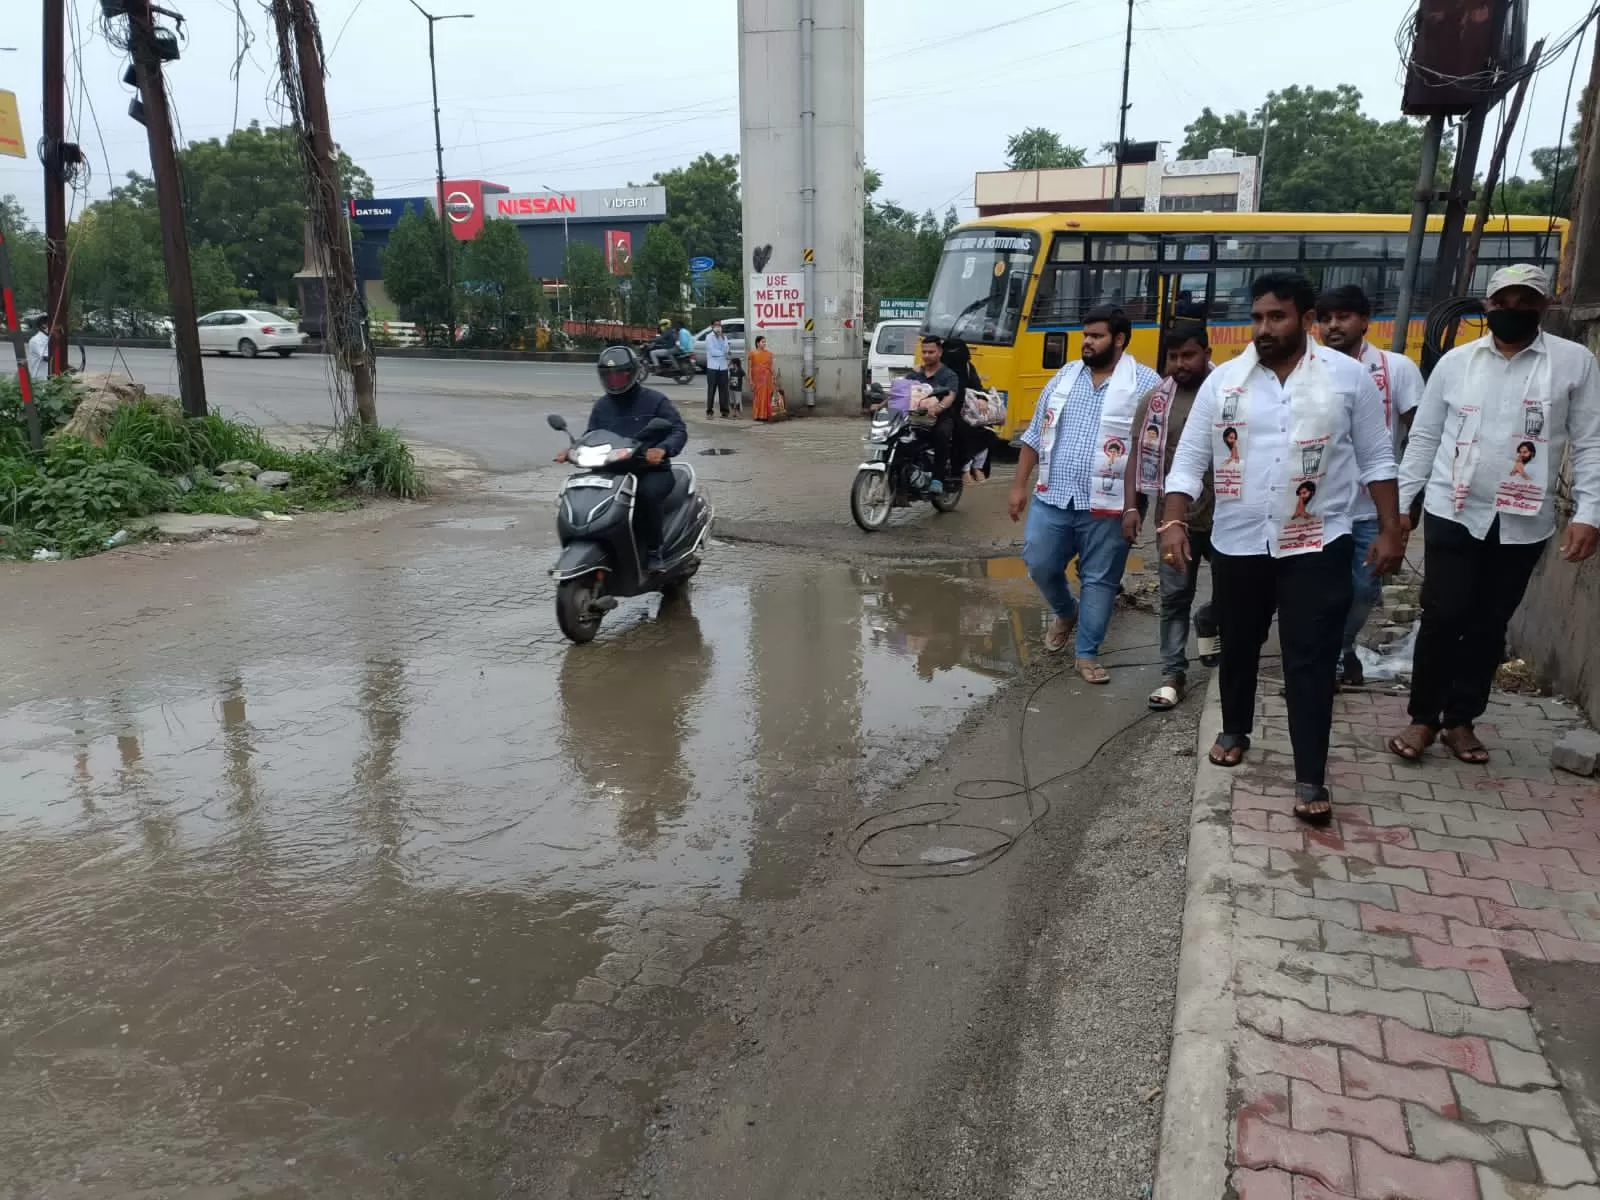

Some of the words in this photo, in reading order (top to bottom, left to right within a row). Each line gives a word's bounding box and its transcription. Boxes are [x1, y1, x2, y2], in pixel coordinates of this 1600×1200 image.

[498, 195, 576, 214] NISSAN
[604, 196, 649, 209] Vibrant
[356, 207, 392, 216] DATSUN
[767, 276, 789, 286] USE
[756, 289, 799, 300] METRO
[754, 303, 805, 318] TOILET
